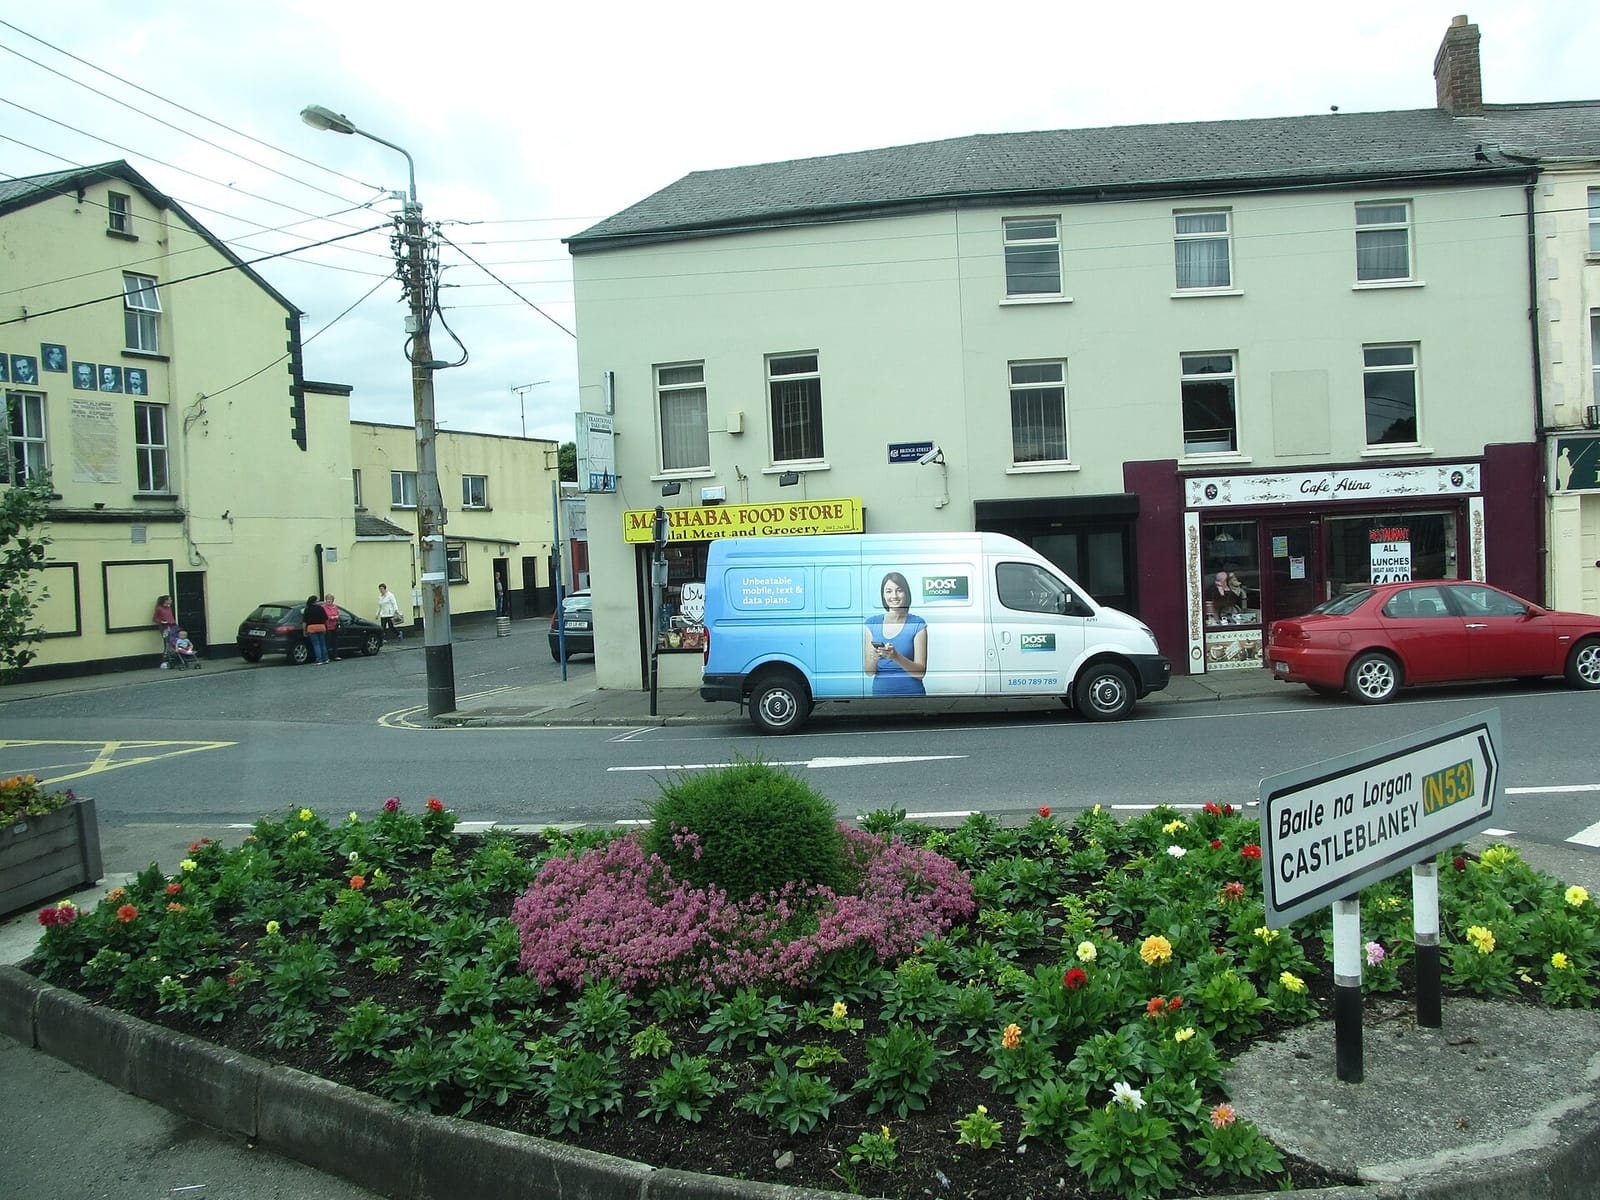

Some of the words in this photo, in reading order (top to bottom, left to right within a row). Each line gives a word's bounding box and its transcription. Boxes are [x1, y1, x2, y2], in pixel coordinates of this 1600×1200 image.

[1334, 478, 1372, 491] Atina
[739, 507, 785, 524] FOOD
[789, 504, 843, 521] STORE
[693, 529, 727, 539] Meat
[732, 526, 757, 537] and
[762, 525, 819, 536] Grocery
[1383, 544, 1399, 552] ALL
[1372, 557, 1410, 566] LUNCHES
[742, 577, 792, 585] Unbeatable
[742, 586, 774, 596] mobile,
[776, 586, 794, 594] text
[795, 585, 803, 593] &
[742, 596, 763, 605] data
[764, 595, 791, 606] plans.
[1422, 761, 1475, 814] (N53)
[1333, 793, 1354, 820] na
[1363, 771, 1412, 809] Lorgan
[1280, 801, 1419, 884] CASTLEBLANEY
